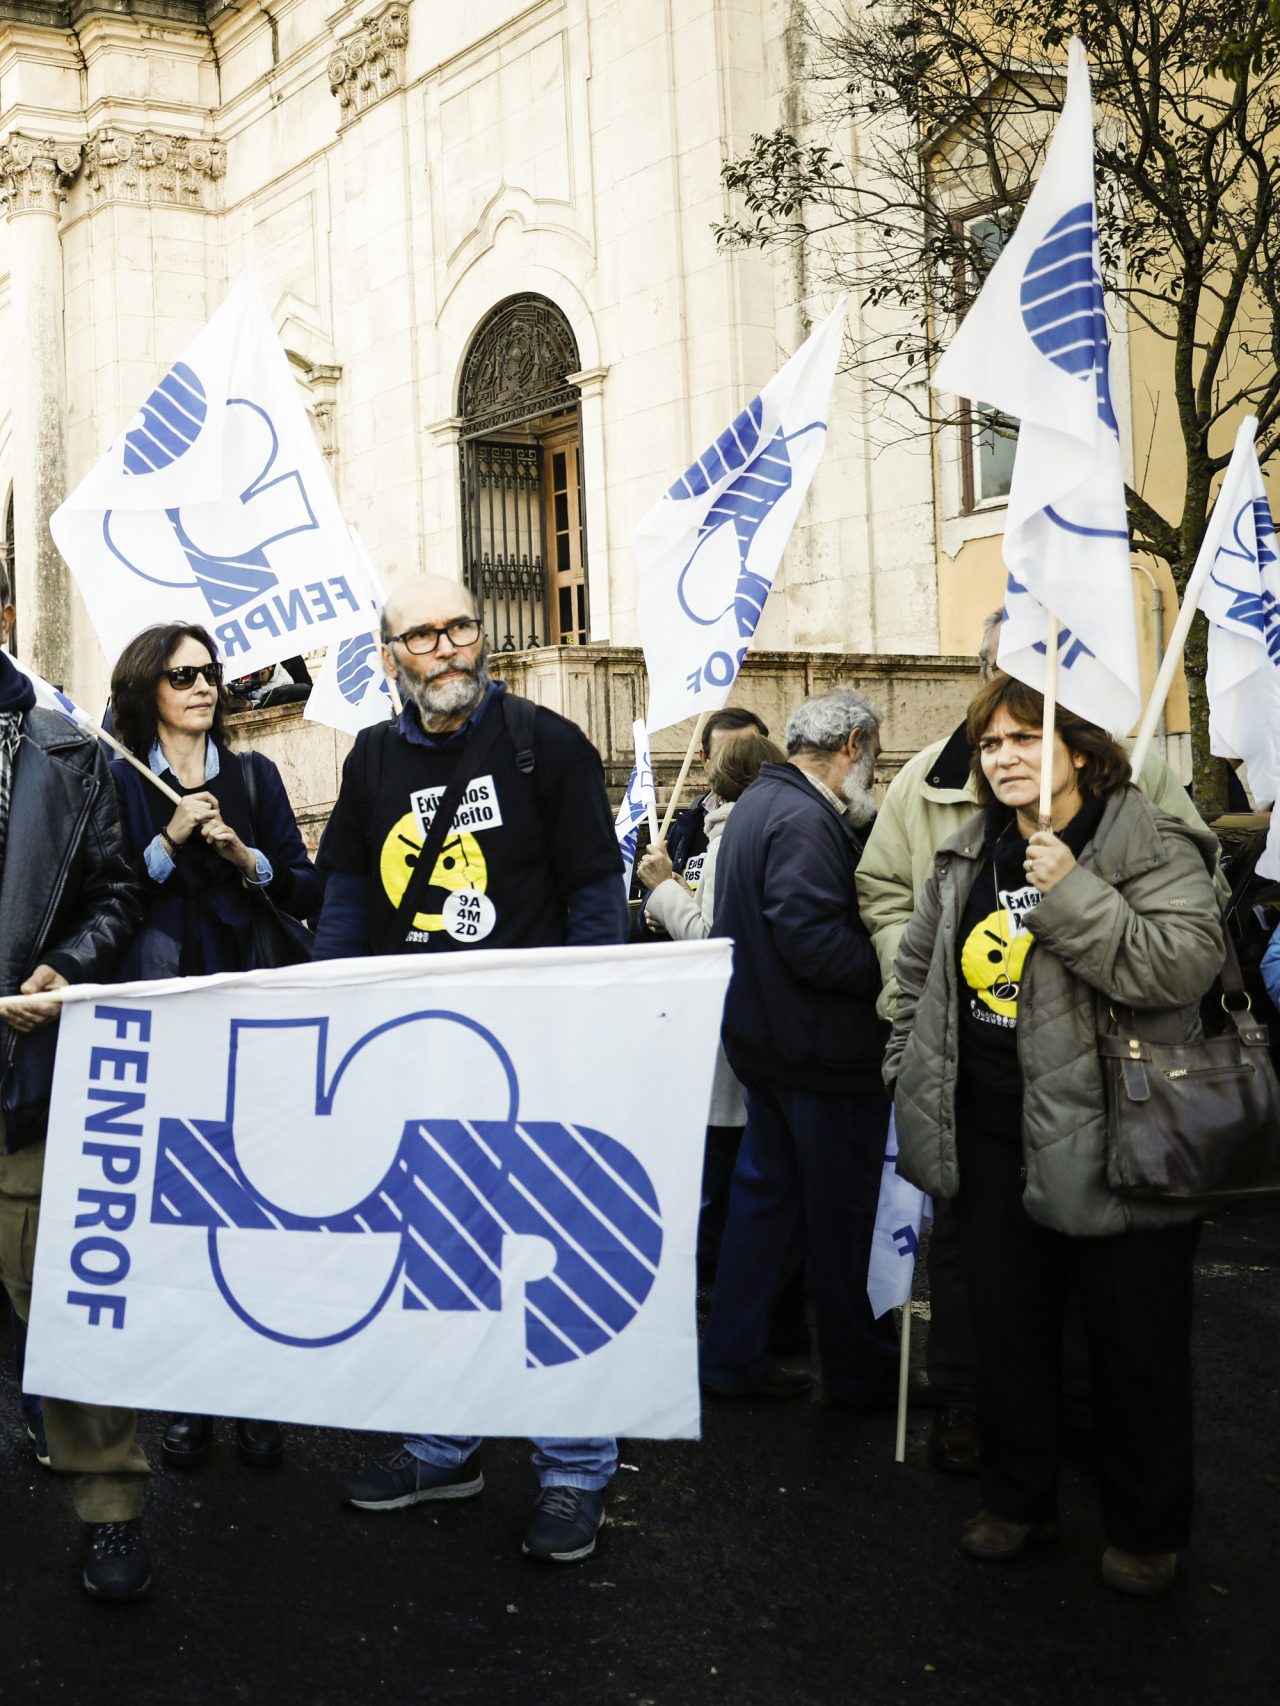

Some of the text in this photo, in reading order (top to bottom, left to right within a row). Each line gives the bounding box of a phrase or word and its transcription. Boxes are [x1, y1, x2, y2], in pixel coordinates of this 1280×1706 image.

[421, 806, 493, 834] Rpeito
[459, 894, 481, 909] 9A
[457, 908, 480, 923] 4M
[455, 922, 478, 936] 2D
[67, 1005, 152, 1329] FENPROF
